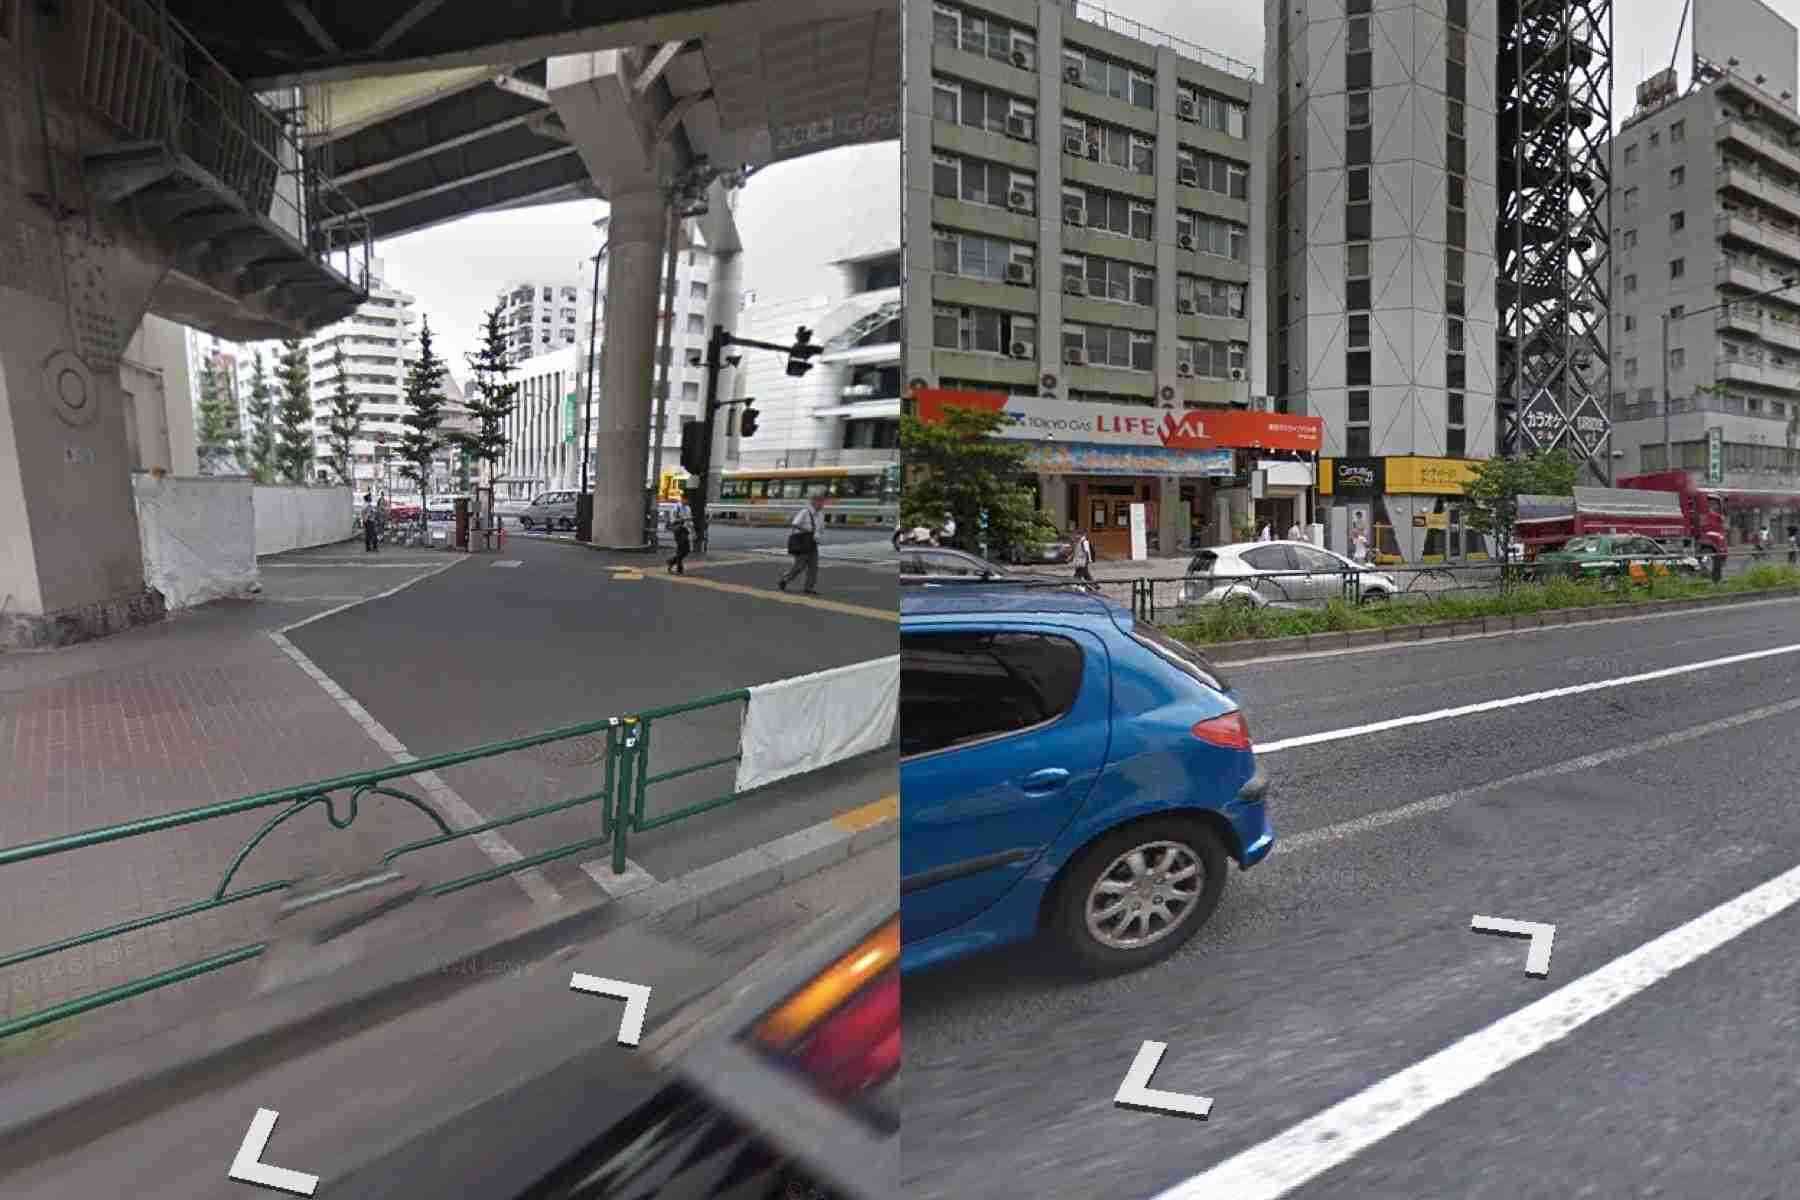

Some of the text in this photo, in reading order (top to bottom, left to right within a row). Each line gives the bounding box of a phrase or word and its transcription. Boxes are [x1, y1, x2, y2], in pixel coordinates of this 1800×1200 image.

[1028, 416, 1068, 430] TOKYO
[1069, 418, 1091, 432] GAS
[1527, 411, 1562, 428] カラオケ
